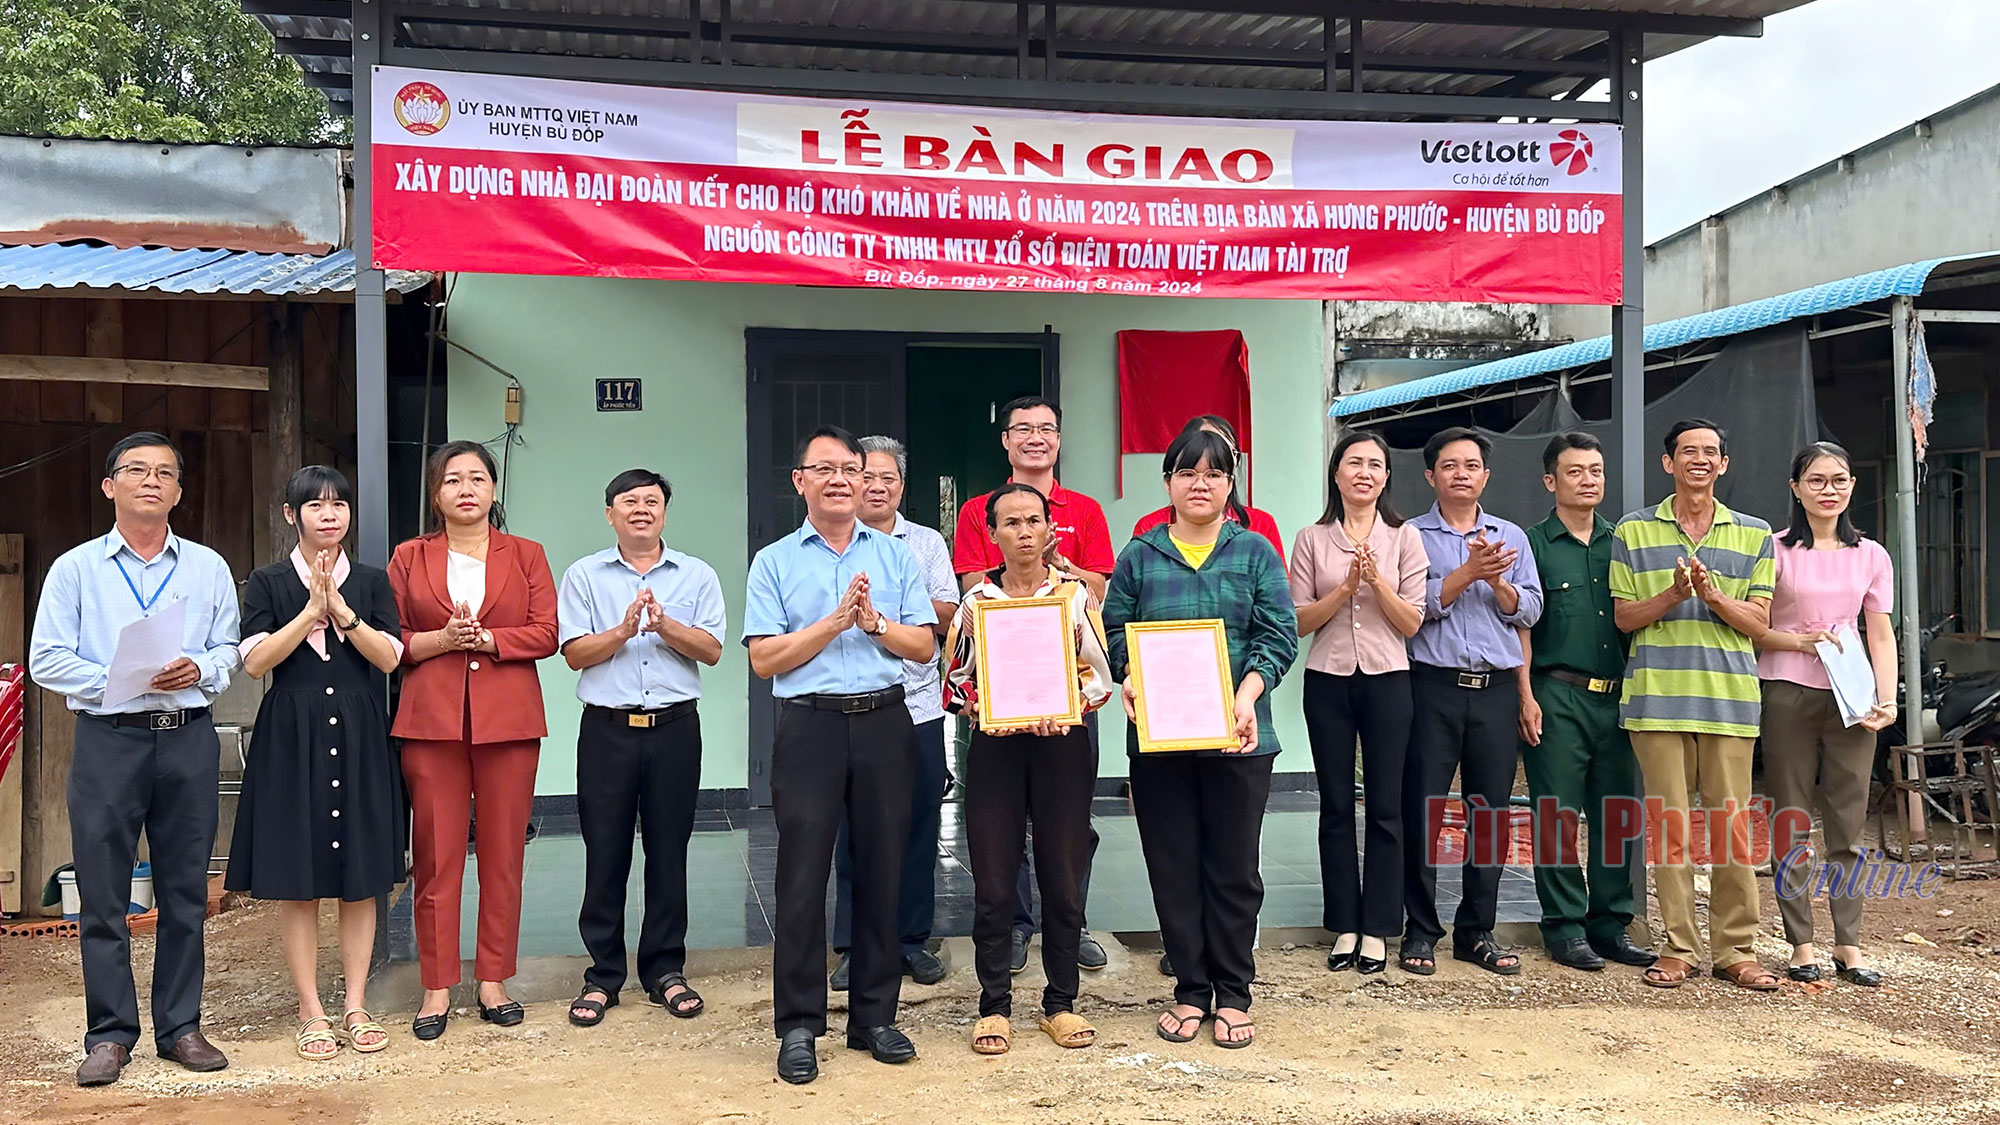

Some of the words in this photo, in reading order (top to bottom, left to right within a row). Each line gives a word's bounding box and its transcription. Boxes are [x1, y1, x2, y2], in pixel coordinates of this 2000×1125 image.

[458, 99, 479, 115] ỦY
[483, 103, 516, 117] BAN
[520, 107, 563, 123] MTTQ
[567, 108, 600, 127] VIỆT
[604, 112, 638, 126] NAM
[489, 122, 541, 140] HUYỆN
[547, 124, 567, 140] BÙ
[572, 126, 604, 143] ĐỐP
[800, 108, 883, 168] LỄ
[903, 125, 1065, 178] BÀN
[1085, 144, 1274, 183] GIAO
[1421, 139, 1541, 164] Vietlott
[1452, 173, 1470, 185] Cơ
[1471, 172, 1491, 187] hội
[1492, 171, 1508, 186] để
[1509, 172, 1526, 186] tốt
[1527, 174, 1549, 187] hơn
[394, 158, 442, 192] XÂY
[449, 164, 514, 201] DỰNG
[520, 166, 569, 199] NHÀ
[575, 172, 614, 207] ĐẠI
[621, 173, 682, 205] ĐOÀN
[688, 173, 730, 209] KẾT
[735, 183, 778, 212] CHO
[786, 182, 815, 219] HỘ
[821, 184, 865, 215] KHÓ
[871, 187, 930, 219] KHĂN
[936, 186, 962, 220] VỀ
[968, 191, 1012, 222] NHÀ
[1018, 189, 1032, 221] Ở
[1037, 194, 1085, 224] NĂM
[1091, 200, 1141, 226] 2024
[1145, 197, 1199, 228] TRÊN
[1203, 203, 1236, 233] ĐỊA
[1244, 200, 1287, 229] BÀN
[1291, 200, 1320, 229] XÃ
[1324, 203, 1379, 231] HƯNG
[1385, 200, 1448, 232] PHƯỚC
[1453, 217, 1461, 225] -
[1466, 203, 1529, 238] HUYỆN
[1536, 203, 1561, 234] BÙ
[1566, 200, 1605, 234] ĐỐP
[704, 220, 781, 254] NGUỒN
[787, 226, 846, 259] CÔNG
[852, 233, 876, 260] TY
[882, 235, 939, 261] TNHH
[944, 238, 987, 264] MTV
[993, 230, 1023, 266] XỔ
[1027, 232, 1057, 267] SỐ
[1061, 237, 1110, 273] ĐIỆN
[1116, 239, 1171, 269] TOÁN
[1177, 239, 1219, 277] VIỆT
[1223, 246, 1269, 272] NAM
[1275, 241, 1306, 273] TÀI
[1312, 246, 1350, 279] TRỢ
[865, 270, 892, 284] Bù
[899, 269, 944, 288] Đốp,
[951, 272, 999, 288] ngày
[1006, 275, 1028, 288] 27
[1033, 275, 1088, 292] tháng
[1095, 278, 1107, 290] 8
[1111, 278, 1152, 292] năm
[1159, 281, 1202, 294] 2024
[604, 382, 634, 400] 117
